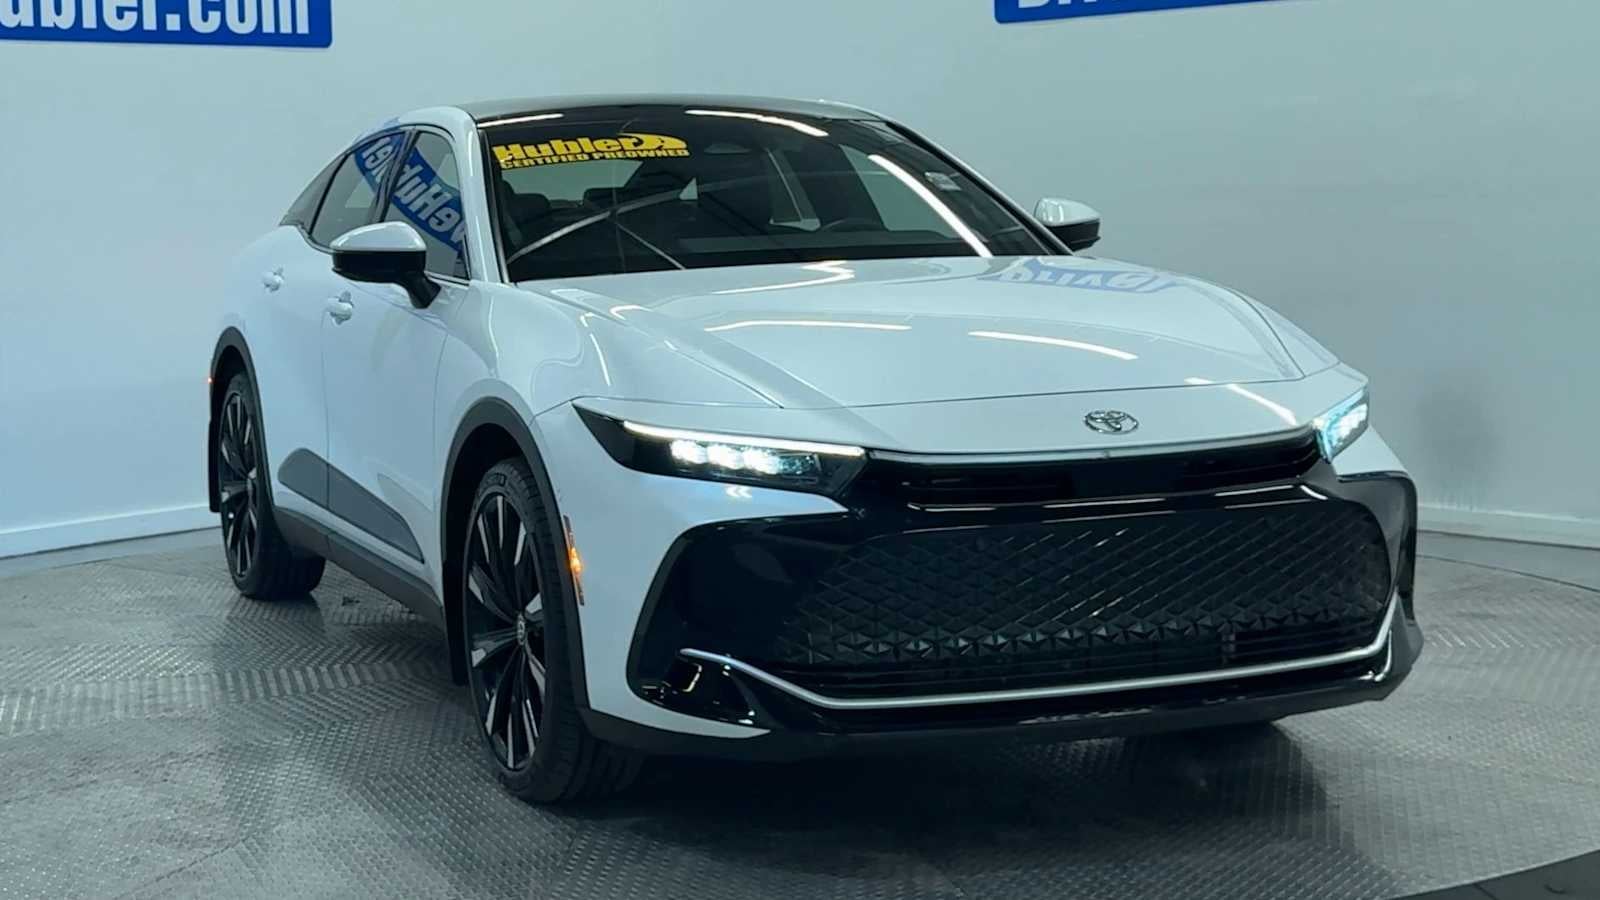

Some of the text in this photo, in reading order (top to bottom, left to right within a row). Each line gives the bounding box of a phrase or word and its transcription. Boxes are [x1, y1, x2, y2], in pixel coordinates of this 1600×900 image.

[492, 137, 642, 163] Hubler
[500, 149, 690, 169] CERTIFIED PREOWNED
